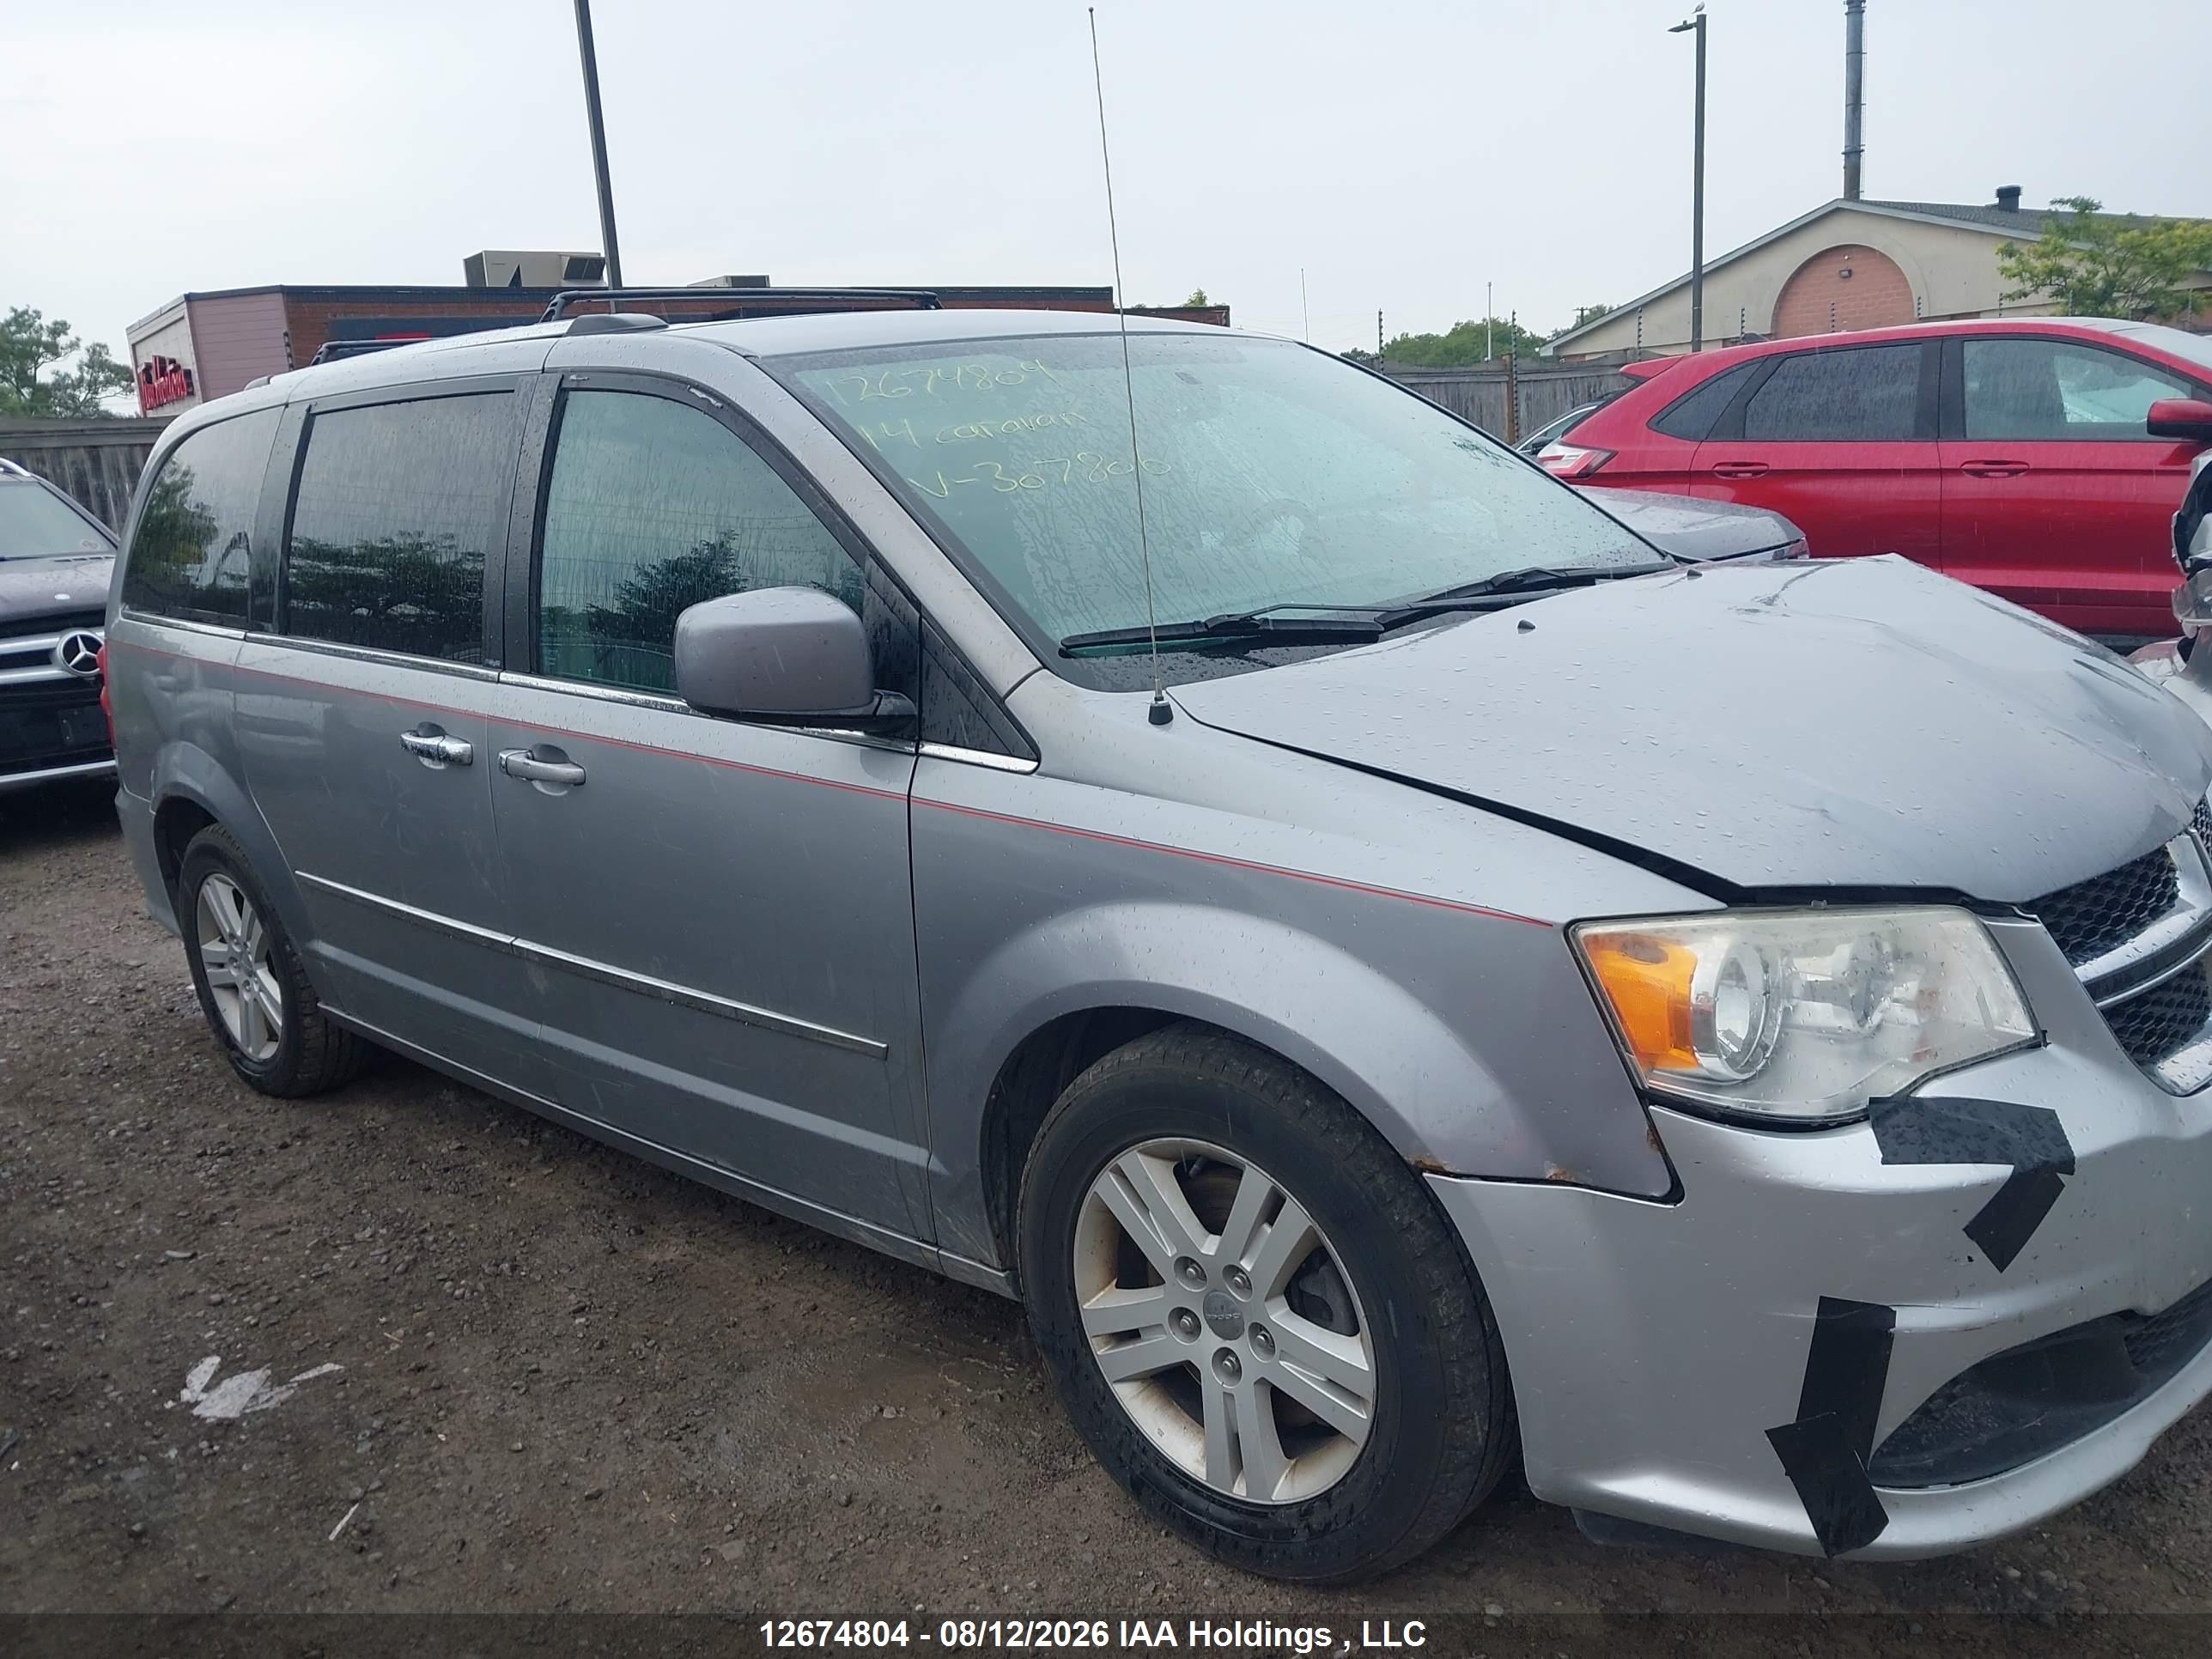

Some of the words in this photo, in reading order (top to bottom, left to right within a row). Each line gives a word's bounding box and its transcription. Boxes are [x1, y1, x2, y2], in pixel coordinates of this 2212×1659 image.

[825, 358, 1063, 407] 12674804
[860, 418, 921, 453] 14
[934, 410, 1088, 445] caravan
